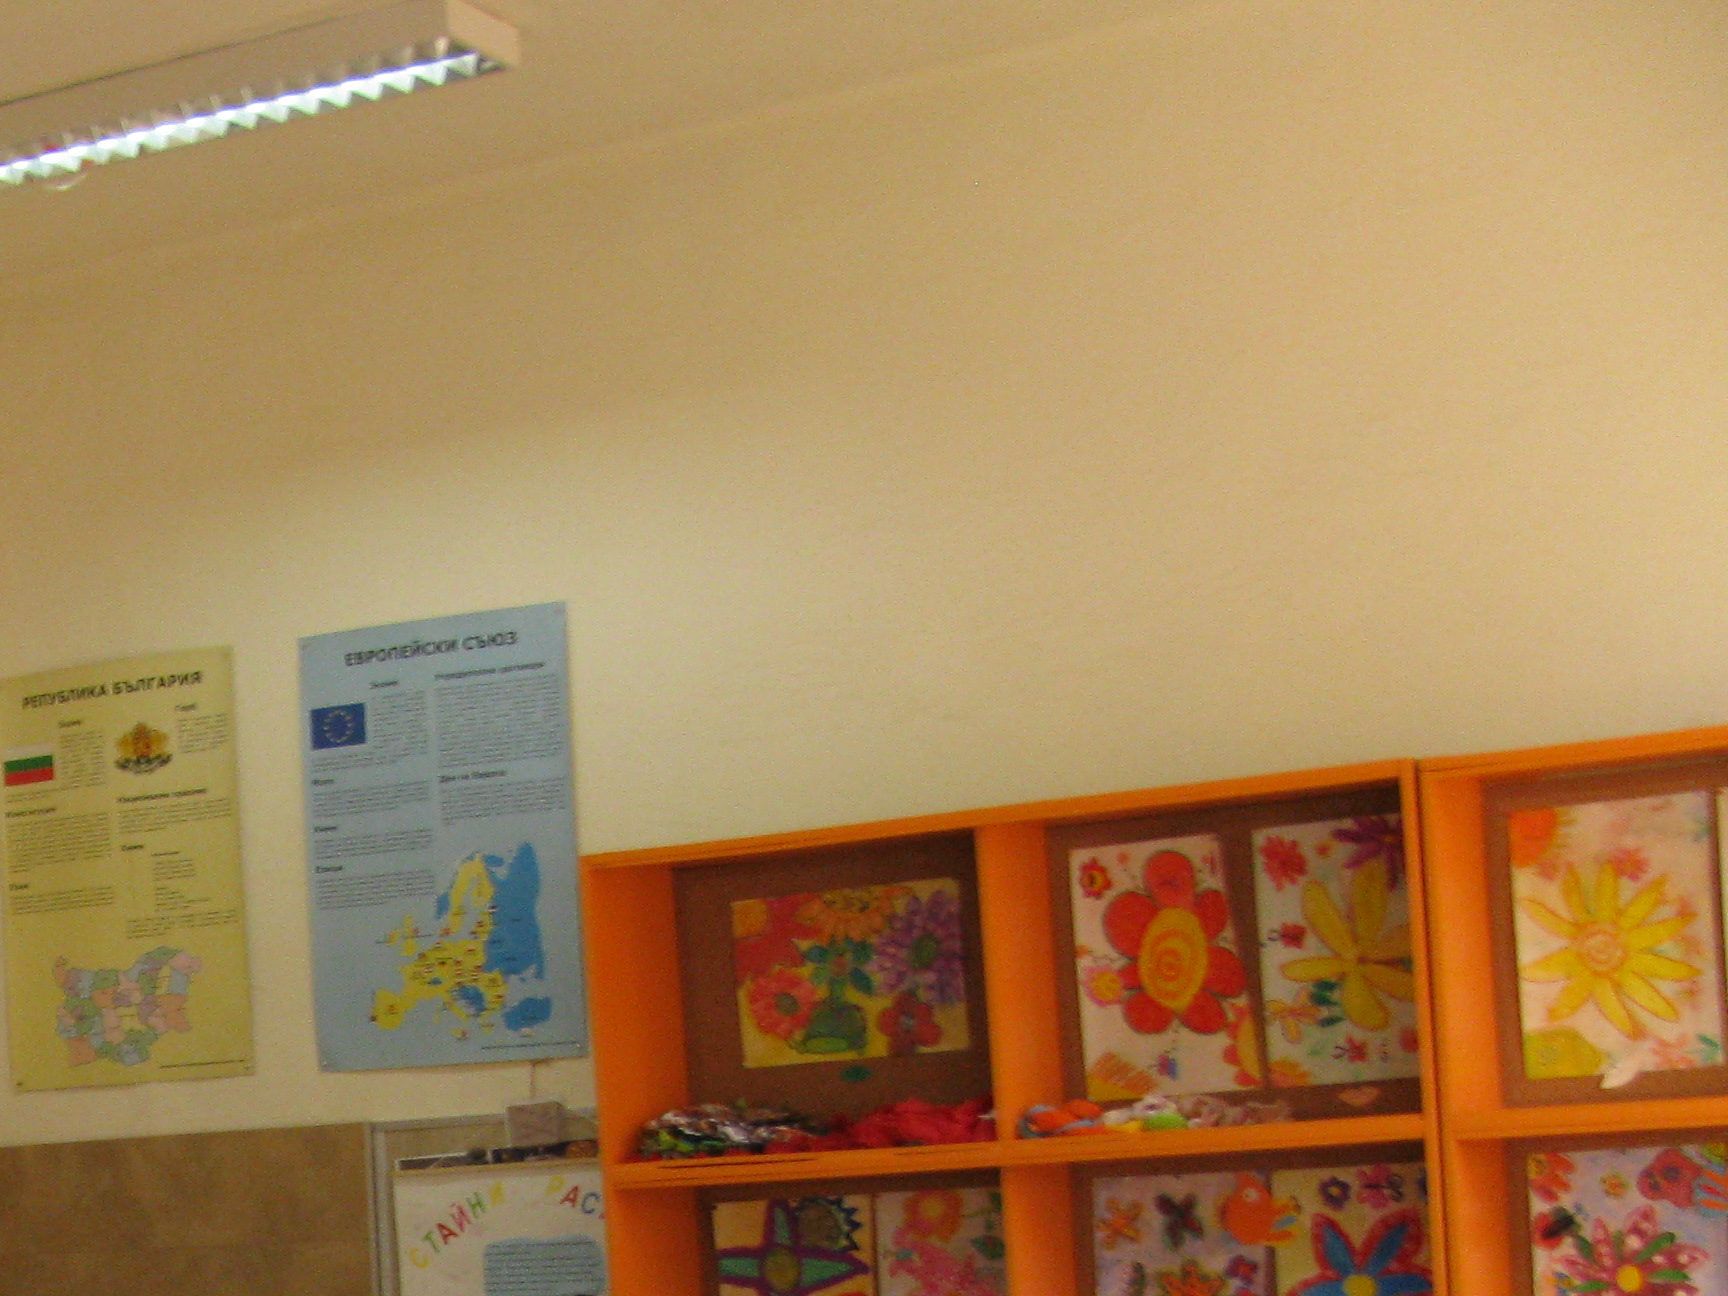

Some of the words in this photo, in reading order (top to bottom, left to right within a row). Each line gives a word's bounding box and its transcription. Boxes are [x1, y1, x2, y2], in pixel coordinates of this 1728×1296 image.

[343, 639, 459, 667] ЕВРОПЕЙСКИ
[462, 631, 519, 651] СЪЮЗ
[22, 683, 108, 710] РЕПУБЛИКА
[111, 670, 204, 695] БЪЛГАРИЯ
[407, 1181, 506, 1269] СТАЙНИ
[543, 1175, 606, 1220] РАС
